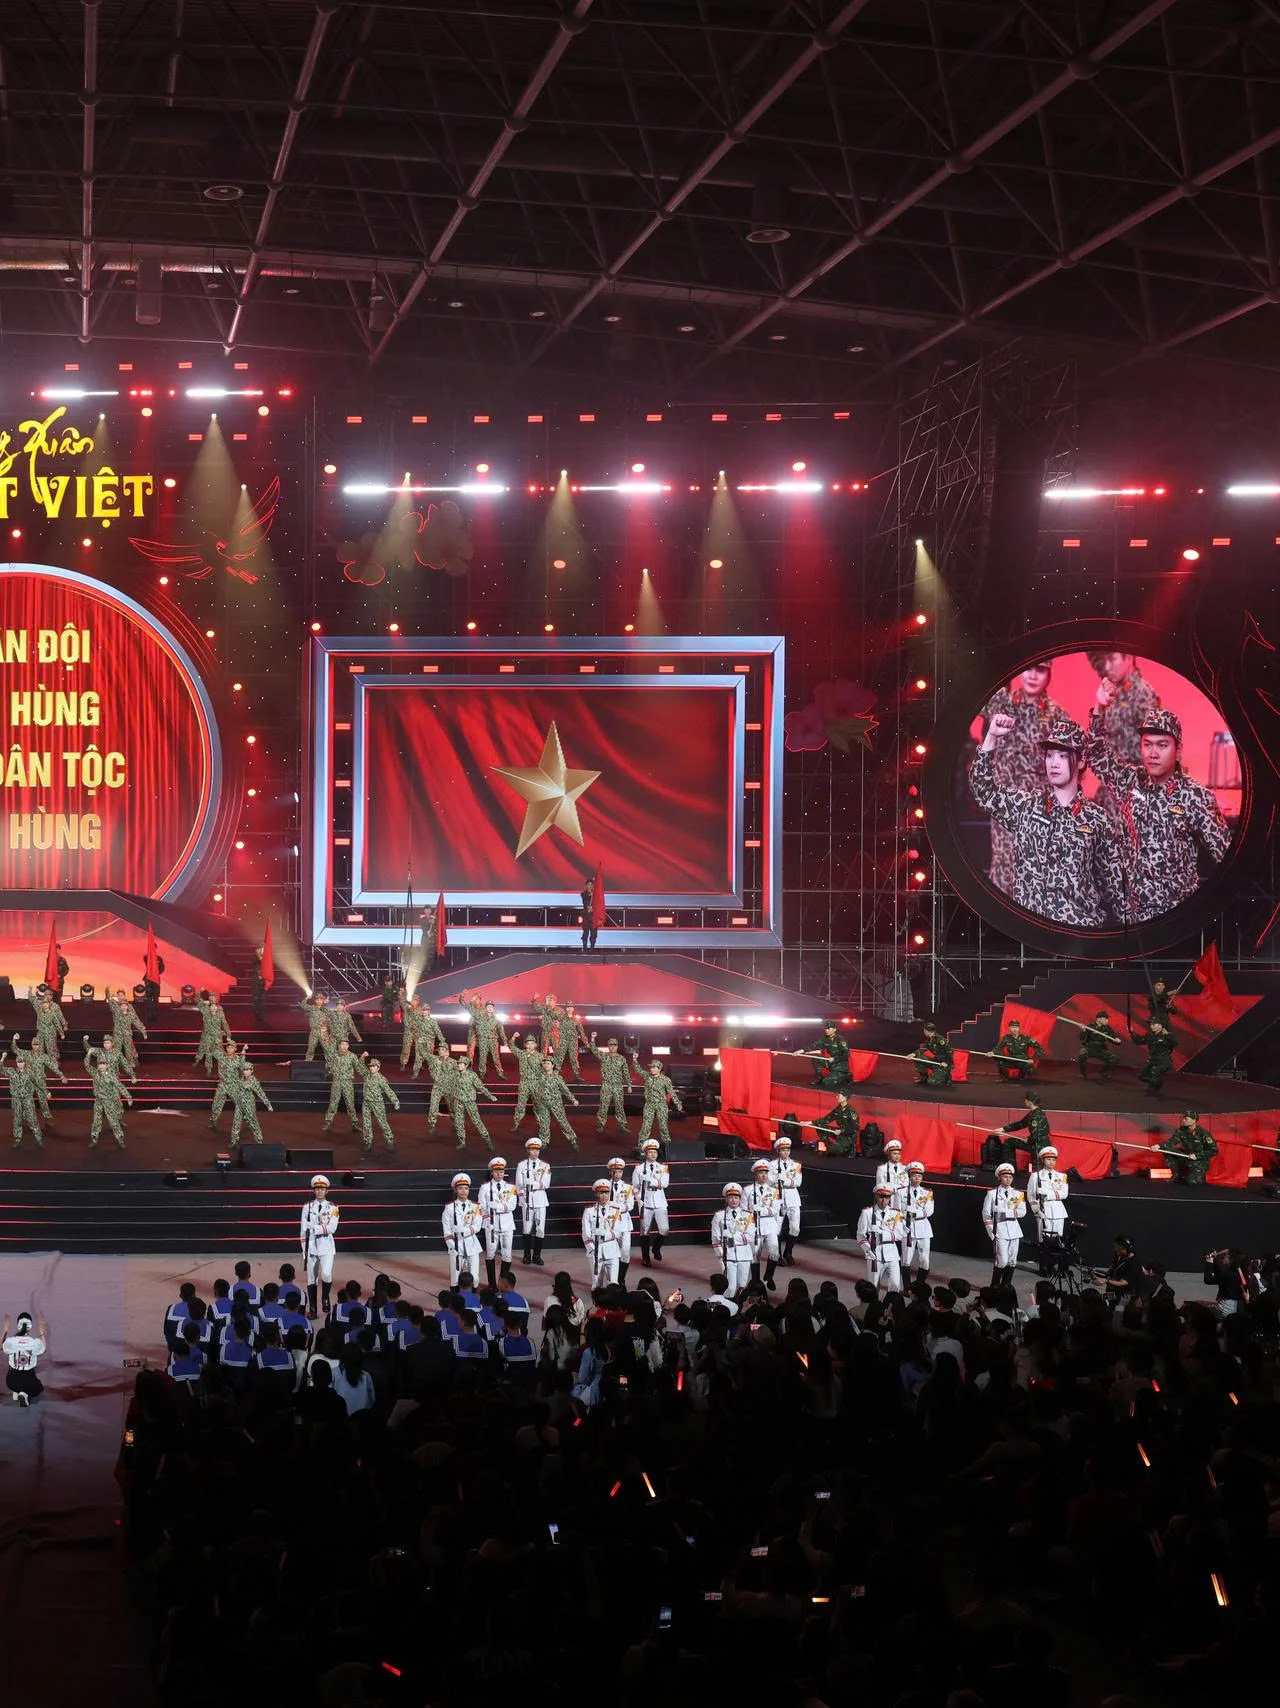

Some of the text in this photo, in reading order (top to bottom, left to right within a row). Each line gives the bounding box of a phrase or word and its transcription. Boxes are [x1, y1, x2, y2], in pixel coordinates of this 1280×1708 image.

[36, 466, 153, 528] VIỆT
[37, 622, 91, 671] ĐỘI
[10, 683, 100, 727] HÙNG
[62, 744, 126, 796] TỘC
[10, 805, 101, 850] HÙNG
